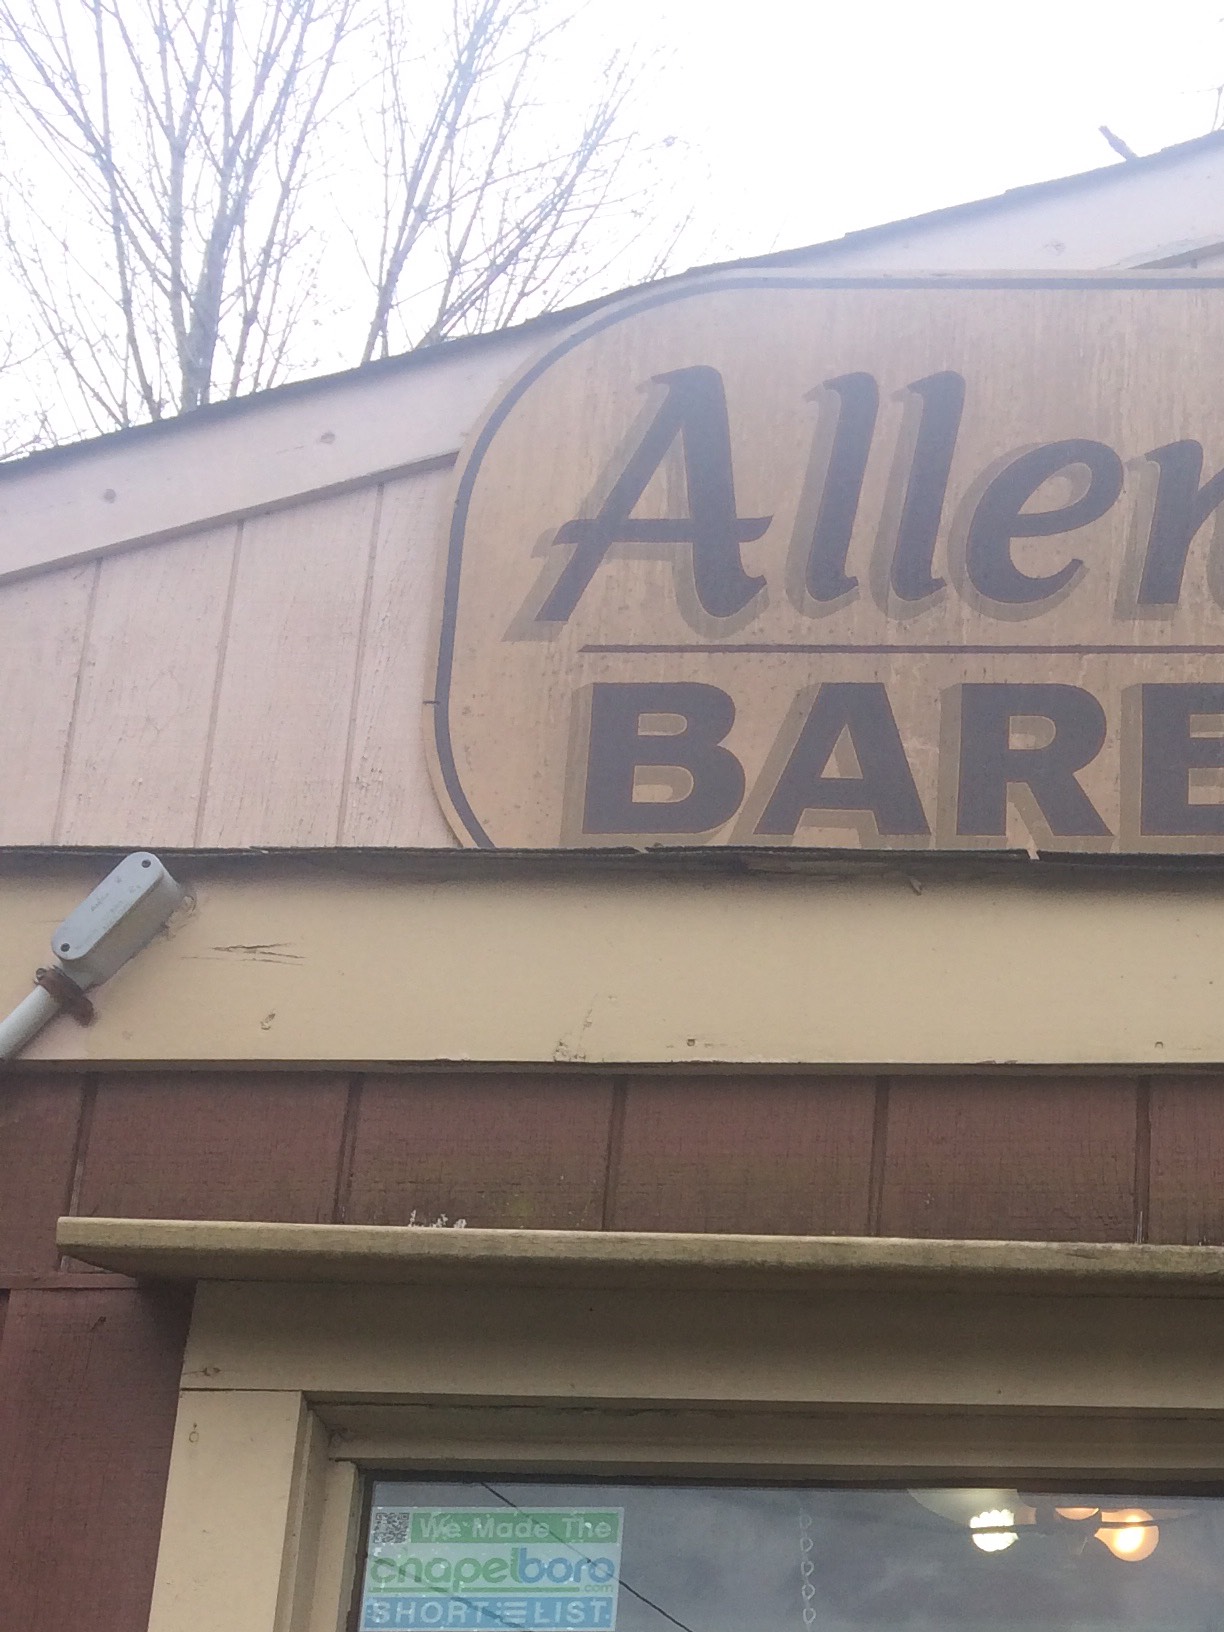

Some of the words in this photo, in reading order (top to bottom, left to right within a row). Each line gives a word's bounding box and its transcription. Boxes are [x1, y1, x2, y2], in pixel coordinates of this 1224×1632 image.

[420, 1518, 461, 1538] We
[472, 1518, 550, 1537] Made
[562, 1517, 611, 1537] The
